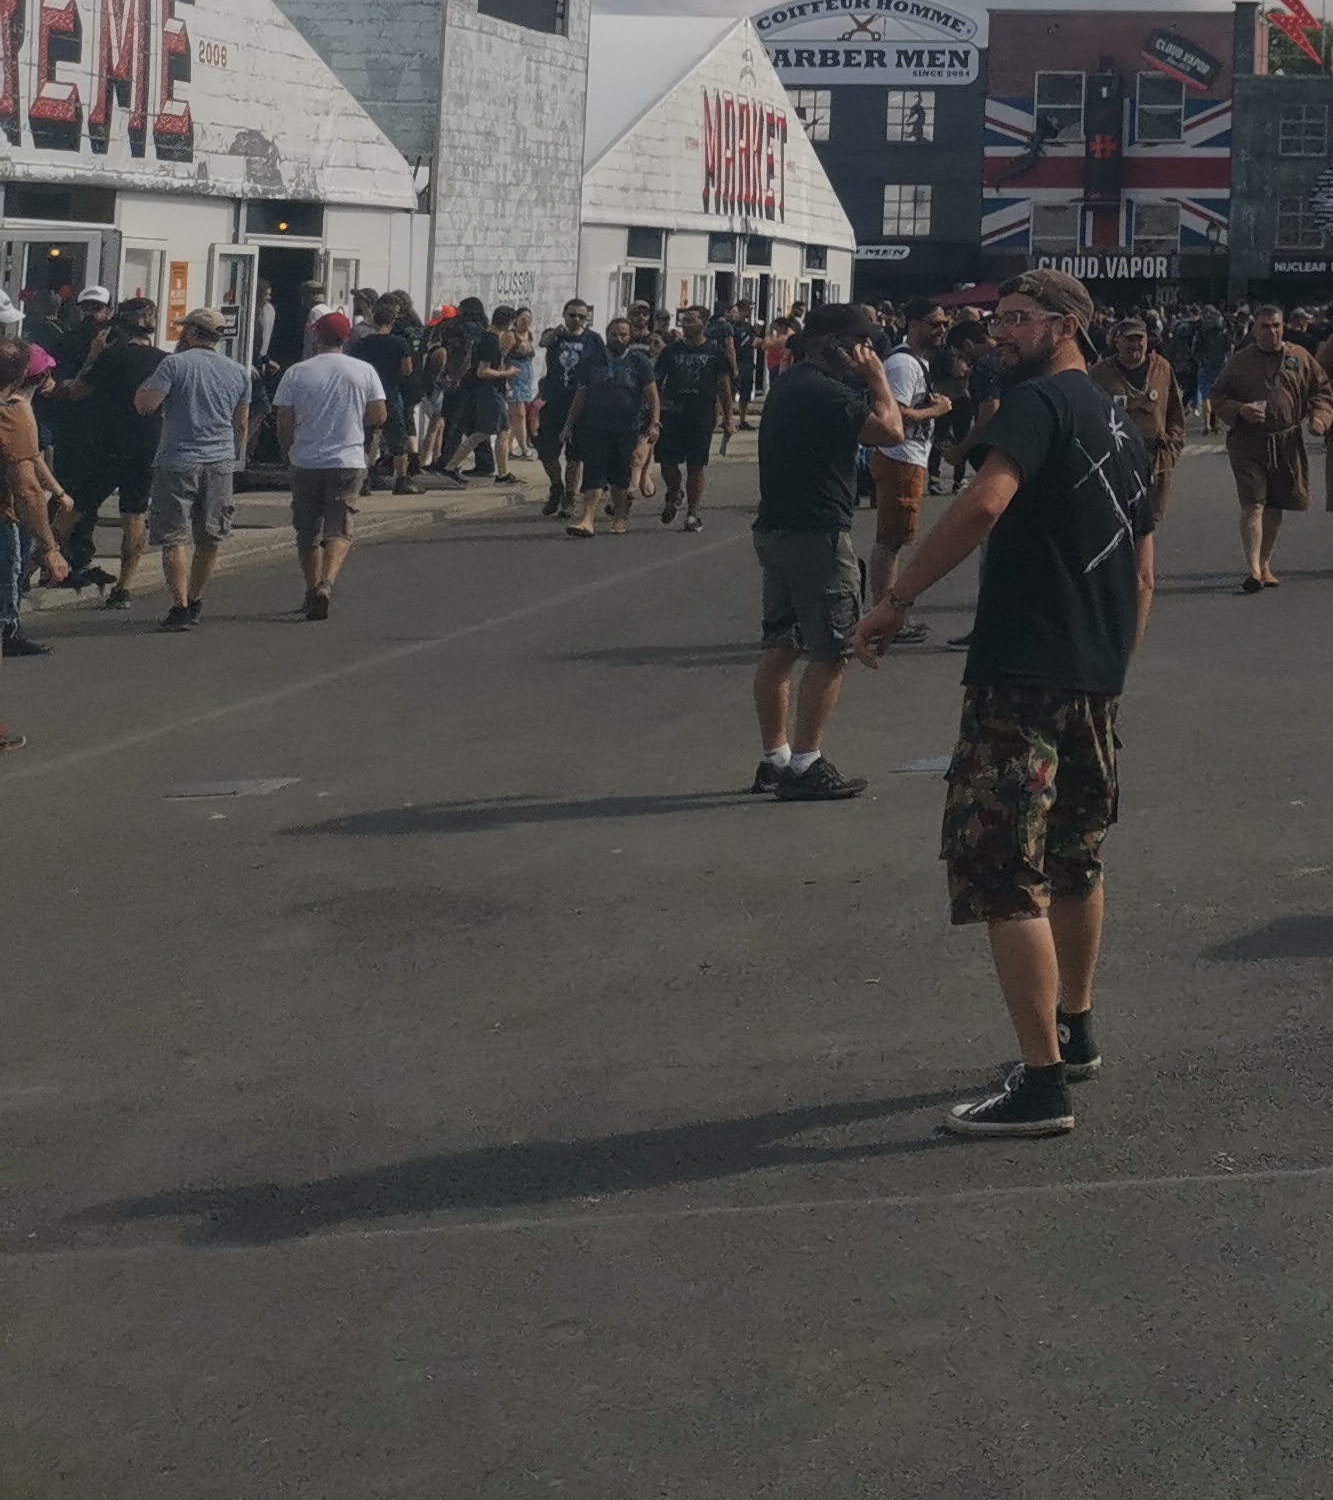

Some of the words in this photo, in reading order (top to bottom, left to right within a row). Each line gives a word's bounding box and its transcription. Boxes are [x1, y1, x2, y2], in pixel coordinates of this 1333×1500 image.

[198, 41, 228, 68] 2008
[768, 49, 888, 69] ARBER
[895, 49, 971, 69] MEN
[701, 85, 788, 224] MARKET
[1274, 261, 1327, 273] NUCLEAR
[496, 270, 536, 295] CLISSON
